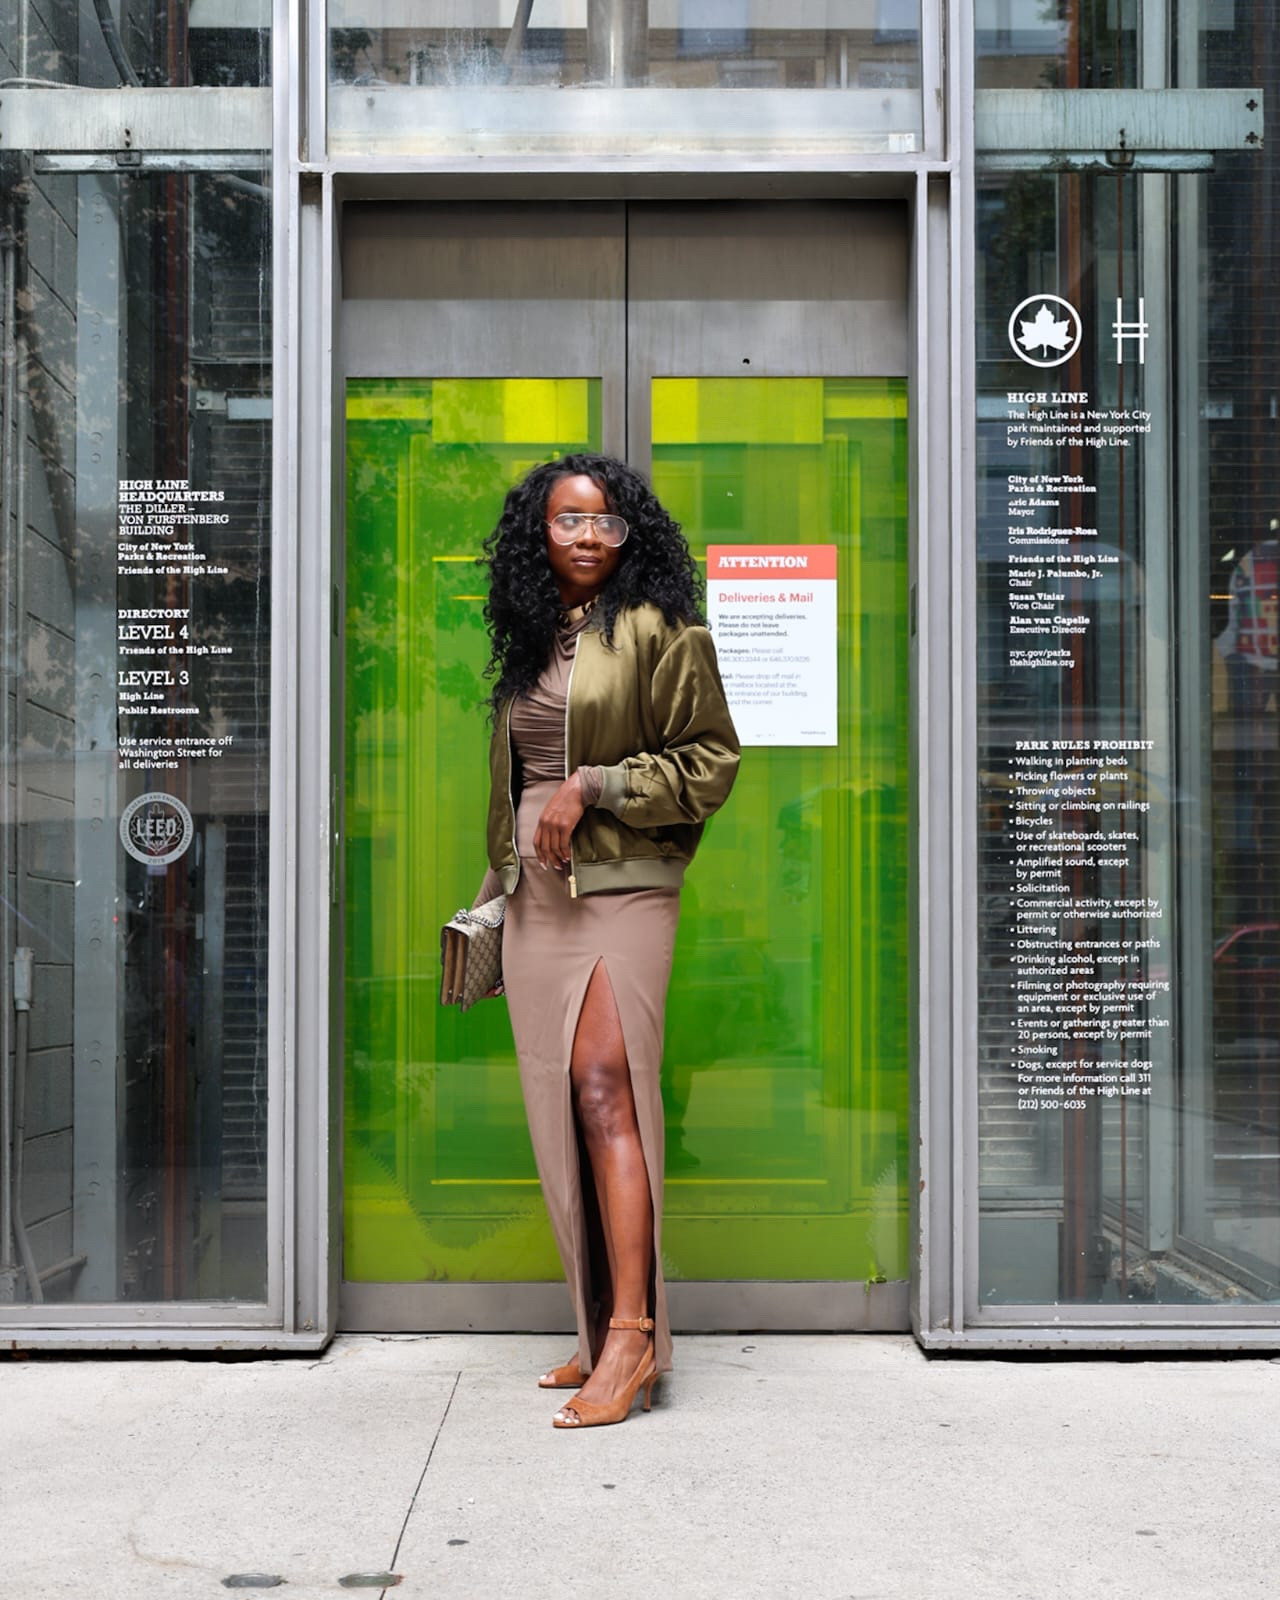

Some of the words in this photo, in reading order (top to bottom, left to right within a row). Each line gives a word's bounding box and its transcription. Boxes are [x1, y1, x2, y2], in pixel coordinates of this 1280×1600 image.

[1007, 393, 1047, 403] HIGH
[1052, 393, 1088, 403] LINE
[1007, 410, 1026, 419] The
[1027, 410, 1048, 421] High
[1050, 411, 1068, 419] Line
[1071, 411, 1078, 419] is
[1087, 411, 1108, 419] New
[1110, 410, 1130, 419] York
[1132, 410, 1150, 421] City
[1008, 424, 1027, 434] park
[1030, 424, 1081, 432] maintained
[1084, 424, 1100, 432] and
[1103, 424, 1150, 434] supported
[1008, 437, 1018, 448] by
[1021, 437, 1053, 446] Friends
[1056, 437, 1066, 446] of
[1068, 437, 1083, 446] the
[1086, 437, 1107, 448] High
[1109, 438, 1130, 446] Line.
[120, 480, 153, 490] HIGH
[156, 480, 188, 490] LINE
[1008, 476, 1028, 485] City
[1062, 475, 1084, 483] York
[1008, 484, 1034, 492] Parks
[120, 492, 224, 503] HEADQUARTERS
[1029, 498, 1060, 506] Adams
[119, 504, 142, 513] THE
[146, 504, 186, 513] DILLER
[1008, 508, 1034, 517] Mayor
[119, 516, 144, 524] VON
[148, 515, 229, 524] FURSTENBERG
[120, 526, 174, 535] BUILDING
[1008, 536, 1069, 544] Commissioner
[118, 544, 138, 553] City
[139, 543, 151, 551] of
[151, 543, 171, 551] New
[173, 543, 194, 551] York
[118, 552, 144, 560] Parks
[146, 552, 154, 560] &
[156, 552, 206, 560] Recreation
[1008, 555, 1044, 563] Friends
[1073, 555, 1096, 564] High
[719, 556, 807, 567] ATTENTION
[118, 566, 153, 574] Friends
[156, 566, 165, 574] of
[166, 566, 181, 574] the
[183, 566, 205, 575] High
[1038, 570, 1044, 579] J.
[1047, 570, 1090, 578] Palumbo,
[1092, 570, 1103, 578] Jr.
[719, 592, 775, 602] Deliveries
[790, 593, 813, 602] Mail
[1010, 602, 1029, 610] Vice
[118, 609, 190, 618] DIRECTORY
[1010, 616, 1032, 625] Alan
[1052, 616, 1090, 626] Capelle
[118, 625, 174, 639] LEVEL
[180, 625, 188, 639] 4
[120, 646, 155, 654] Friends
[158, 646, 167, 654] of
[169, 646, 184, 654] the
[186, 646, 208, 655] High
[1010, 649, 1070, 659] nyc.gov/parks
[1010, 658, 1074, 668] thehighline.org
[119, 671, 174, 685] LEVEL
[180, 671, 189, 684] 3
[120, 692, 141, 702] High
[144, 692, 164, 700] Line
[119, 706, 148, 714] Public
[150, 706, 199, 714] Restrooms
[118, 738, 136, 746] Use
[140, 737, 172, 746] service
[174, 738, 216, 747] entrance
[218, 736, 232, 745] off
[1016, 741, 1048, 750] PARK
[1052, 741, 1090, 749] RULES
[1094, 740, 1153, 749] PROHIBIT
[119, 748, 174, 759] Washington
[178, 748, 206, 757] Street
[208, 747, 222, 756] for
[119, 760, 130, 768] all
[133, 759, 178, 768] deliveries
[1015, 756, 1052, 768] Walking
[1066, 756, 1104, 768] planting
[1106, 756, 1128, 765] beds
[1015, 771, 1048, 783] Picking
[1050, 771, 1084, 781] flowers
[1100, 771, 1128, 782] plants
[1016, 786, 1060, 797] Throwing
[1061, 786, 1096, 797] objects
[1016, 816, 1053, 827] Bicycles
[136, 818, 176, 837] LEED
[1017, 884, 1070, 892] Solicitation
[1017, 925, 1056, 936] Littering
[1017, 940, 1072, 951] Obstructing
[1135, 939, 1160, 950] paths
[1018, 1045, 1058, 1056] Smoking
[1018, 1074, 1033, 1082] For
[1063, 1073, 1117, 1082] information
[1120, 1074, 1135, 1082] call
[1138, 1074, 1150, 1082] 311
[1031, 1086, 1064, 1095] Friends
[1066, 1086, 1077, 1095] of
[1079, 1086, 1095, 1095] the
[1098, 1086, 1119, 1097] High
[1121, 1086, 1140, 1094] Line
[1018, 1099, 1038, 1110] (212)
[1041, 1100, 1086, 1109] 500-6035
